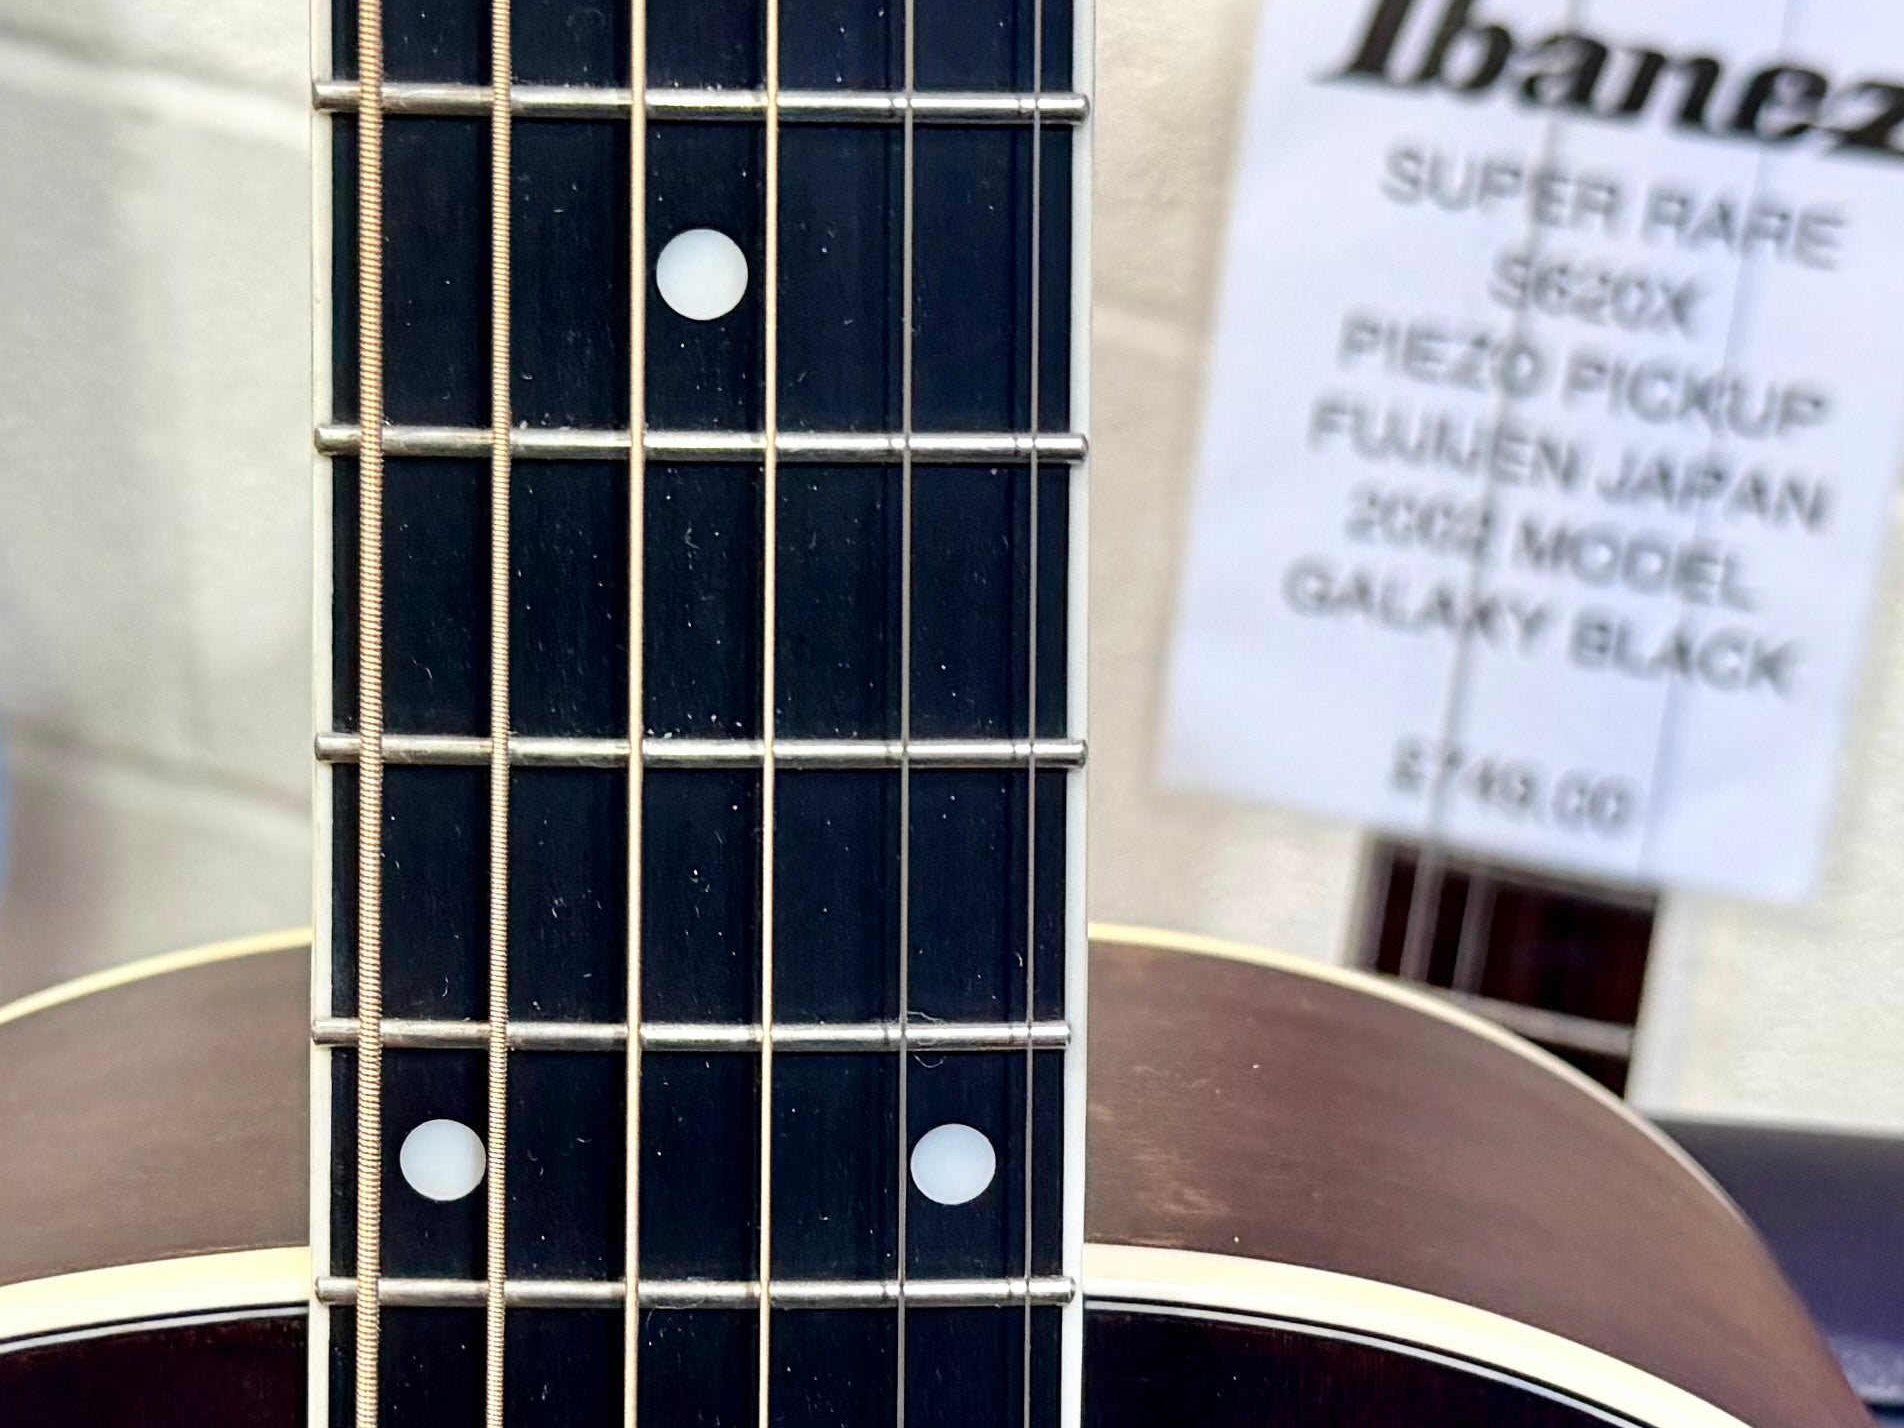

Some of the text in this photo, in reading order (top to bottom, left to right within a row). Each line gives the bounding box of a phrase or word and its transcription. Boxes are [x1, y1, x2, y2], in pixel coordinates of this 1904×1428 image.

[1385, 144, 1848, 266] SUPER RARE
[1491, 247, 1703, 332] S620X
[1342, 314, 1830, 434] PIEZO PICKUP
[1600, 453, 1830, 528] JAPAN
[1518, 519, 1755, 605] MODEL
[1285, 561, 1798, 692] GALAXY BLACK
[1392, 739, 1635, 831] £749.00
